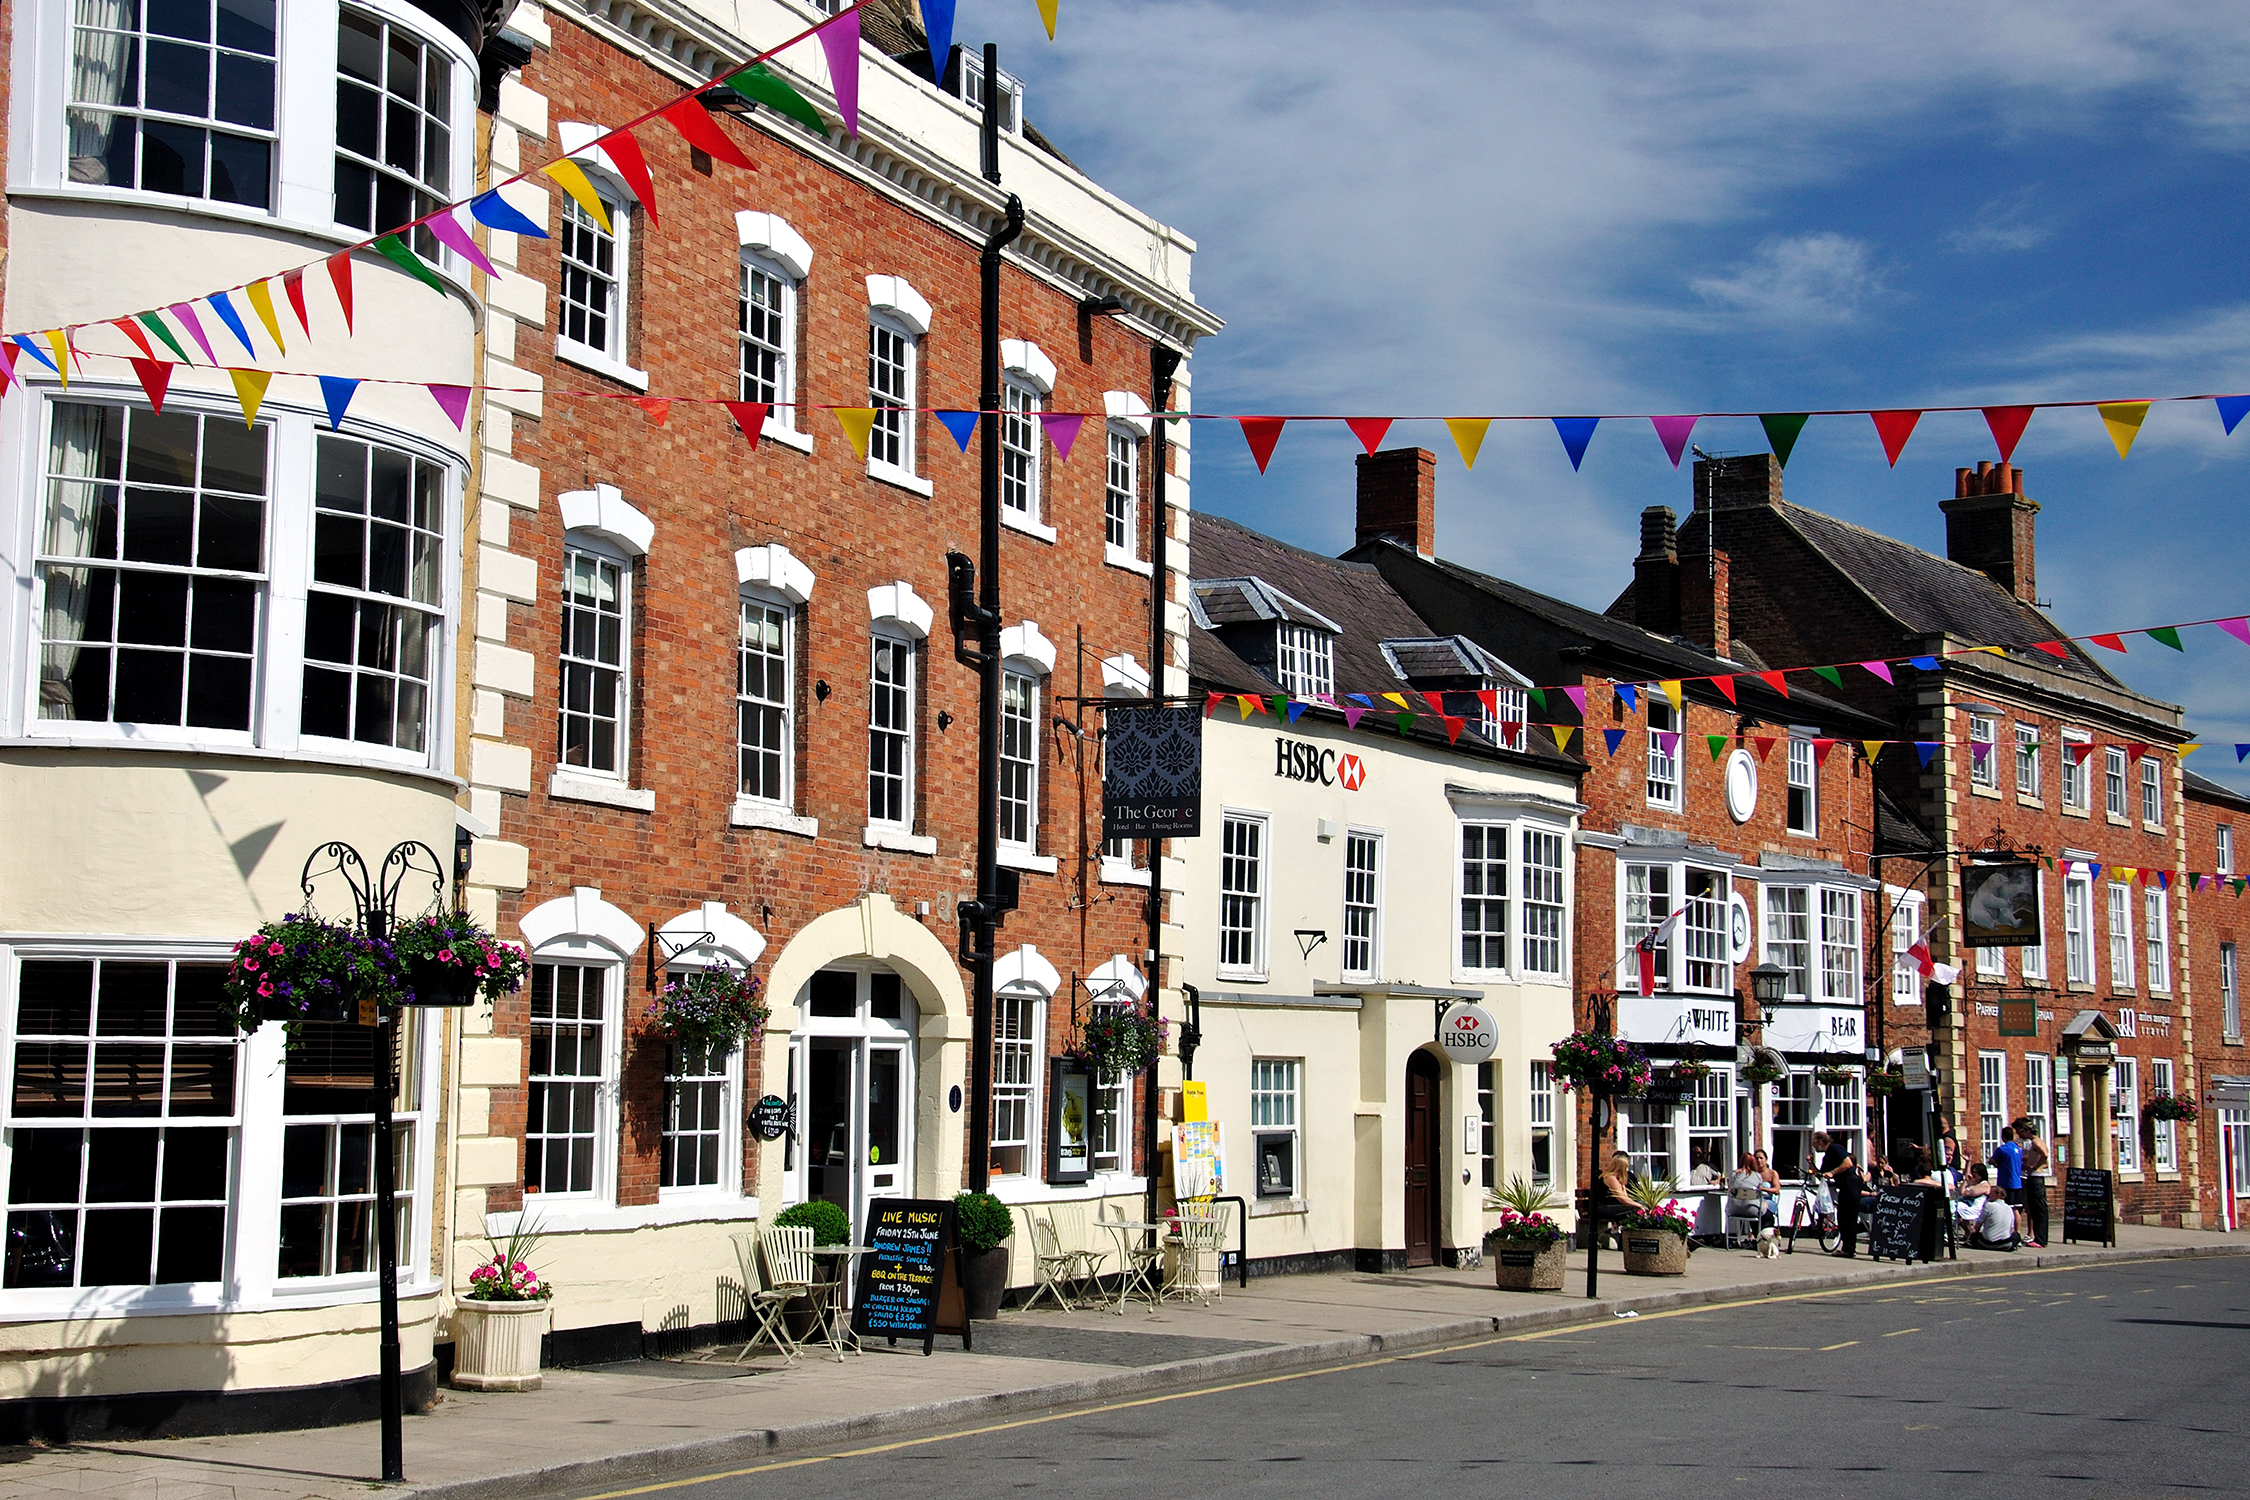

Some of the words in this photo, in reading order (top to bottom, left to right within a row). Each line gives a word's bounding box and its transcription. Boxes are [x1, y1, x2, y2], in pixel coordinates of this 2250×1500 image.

[1274, 737, 1335, 787] HSBC
[1114, 806, 1140, 819] The
[1692, 1008, 1729, 1032] WHITE
[1831, 1016, 1857, 1036] BEAR
[2141, 1025, 2168, 1037] travel
[1444, 1032, 1490, 1048] HSBC
[1676, 1092, 1694, 1101] HERE
[1880, 1193, 1900, 1204] FRESH
[1902, 1196, 1920, 1208] FOOD
[882, 1211, 903, 1223] LIVE
[876, 1226, 902, 1238] FRIDAY
[902, 1228, 919, 1239] 25TH
[920, 1228, 939, 1240] JUNE
[878, 1254, 904, 1262] ACOUSTIC
[906, 1256, 928, 1264] SINGER
[871, 1269, 886, 1280] BBQ
[887, 1272, 897, 1280] ON
[897, 1273, 908, 1281] THE
[908, 1274, 934, 1284] TERRACE
[879, 1283, 894, 1292] FROM
[870, 1294, 895, 1303] BURGER
[872, 1303, 899, 1312] CHICKEN
[900, 1305, 922, 1314] KEBAB
[873, 1311, 894, 1319] SALAD
[909, 1322, 927, 1330] DRINK
